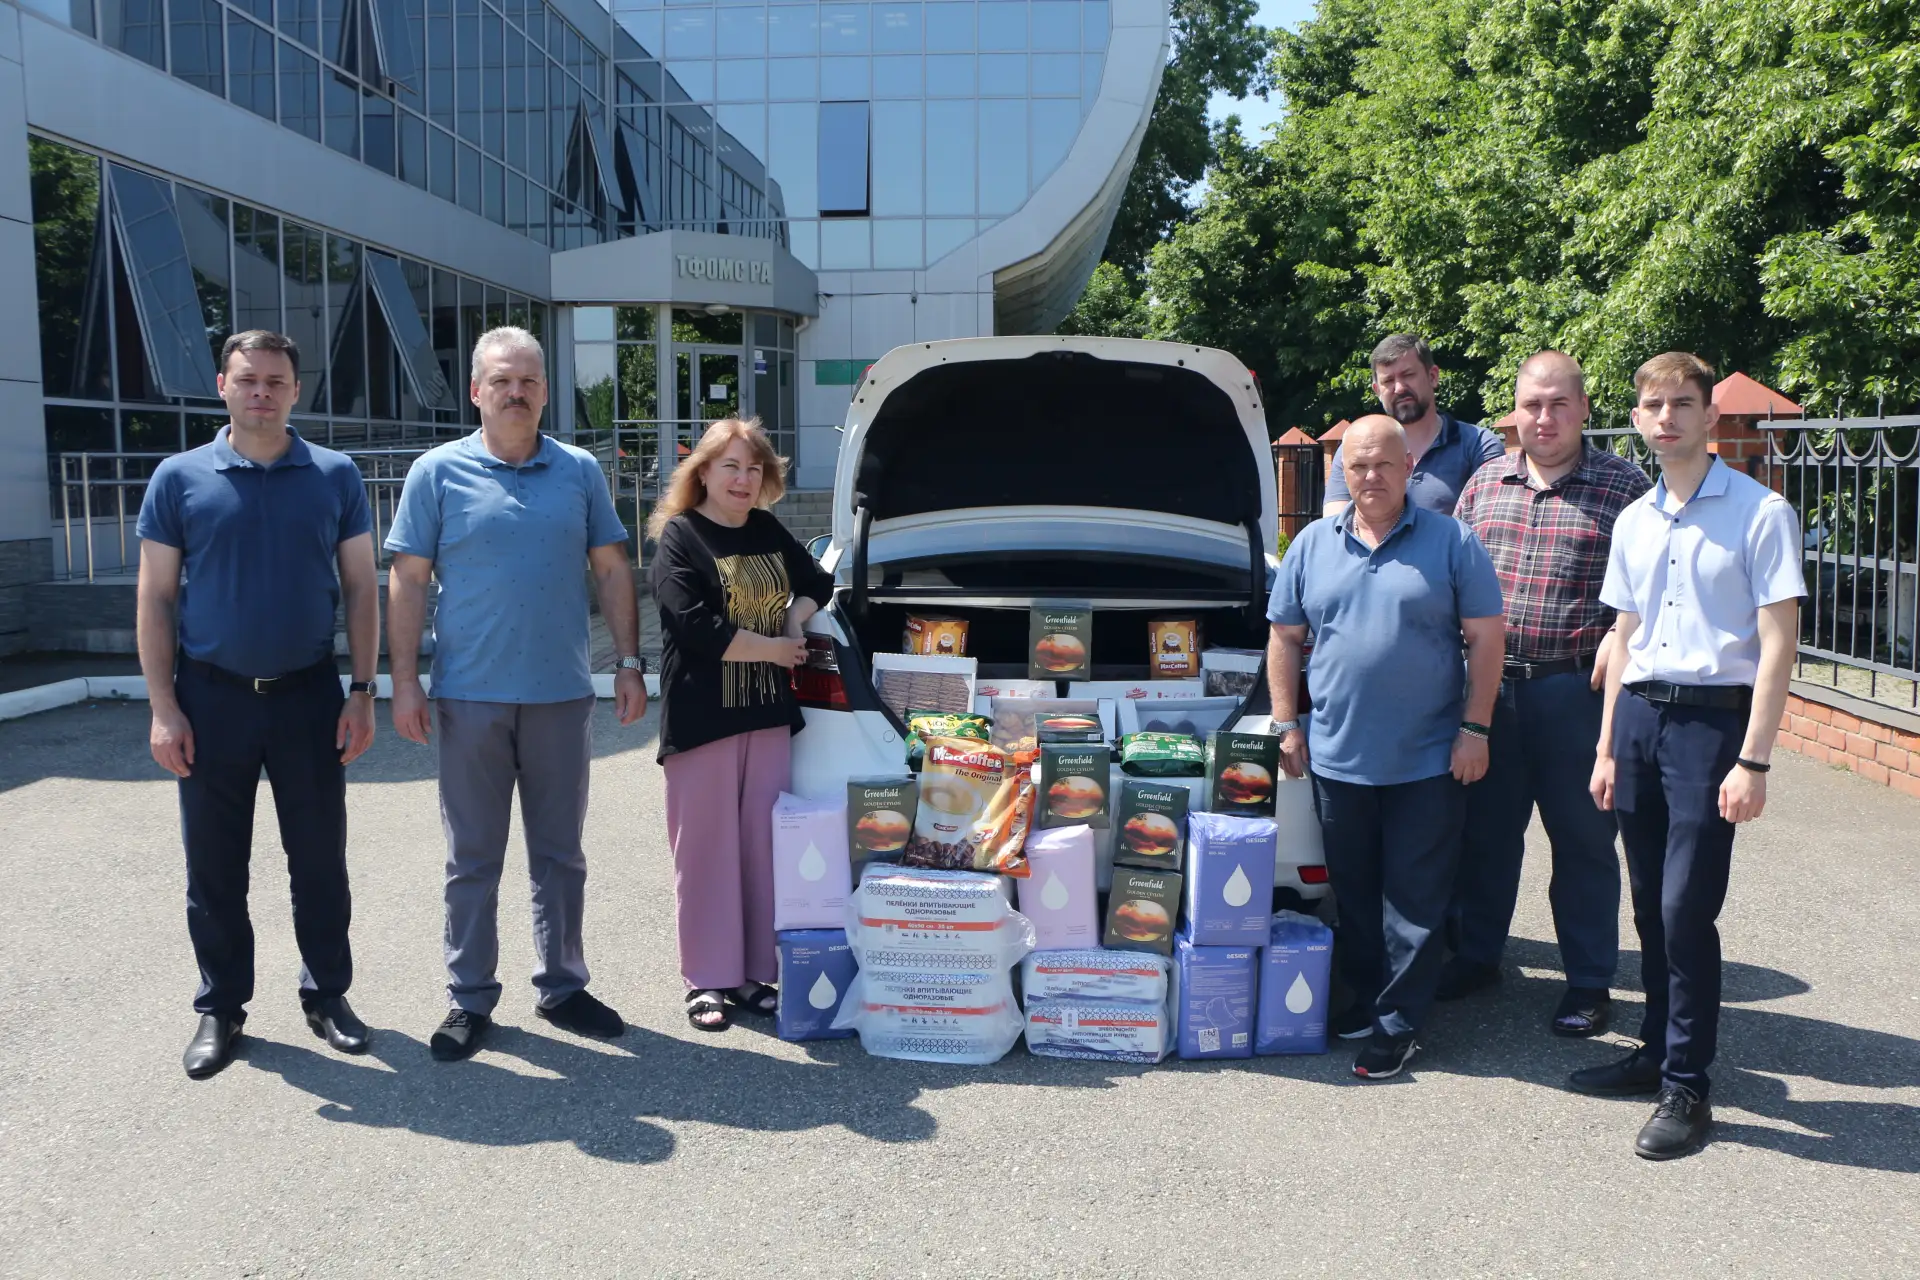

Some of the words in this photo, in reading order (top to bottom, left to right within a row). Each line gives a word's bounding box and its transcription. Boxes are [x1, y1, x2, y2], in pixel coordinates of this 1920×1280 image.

[677, 254, 744, 282] ТФОМС
[750, 260, 772, 285] РА
[1045, 614, 1077, 624] Greenfield
[1231, 740, 1264, 750] Greenfield
[932, 746, 1003, 768] MacCoffee
[1058, 754, 1093, 765] Greenfield
[955, 768, 969, 777] The
[971, 772, 1003, 782] Original
[863, 788, 899, 798] Greenfield
[1137, 789, 1172, 801] Greenfield
[1128, 877, 1164, 889] Greenfield
[886, 900, 917, 908] ПЕЛЁНКИ
[919, 901, 976, 909] ВПИТЫВАЮЩИЕ
[904, 908, 957, 916] ОДНОРАЗОВЫЕ
[917, 987, 973, 995] ВПИТЫВАЮЩИЕ
[902, 993, 955, 1001] ОДНОРАЗОВЫЕ
